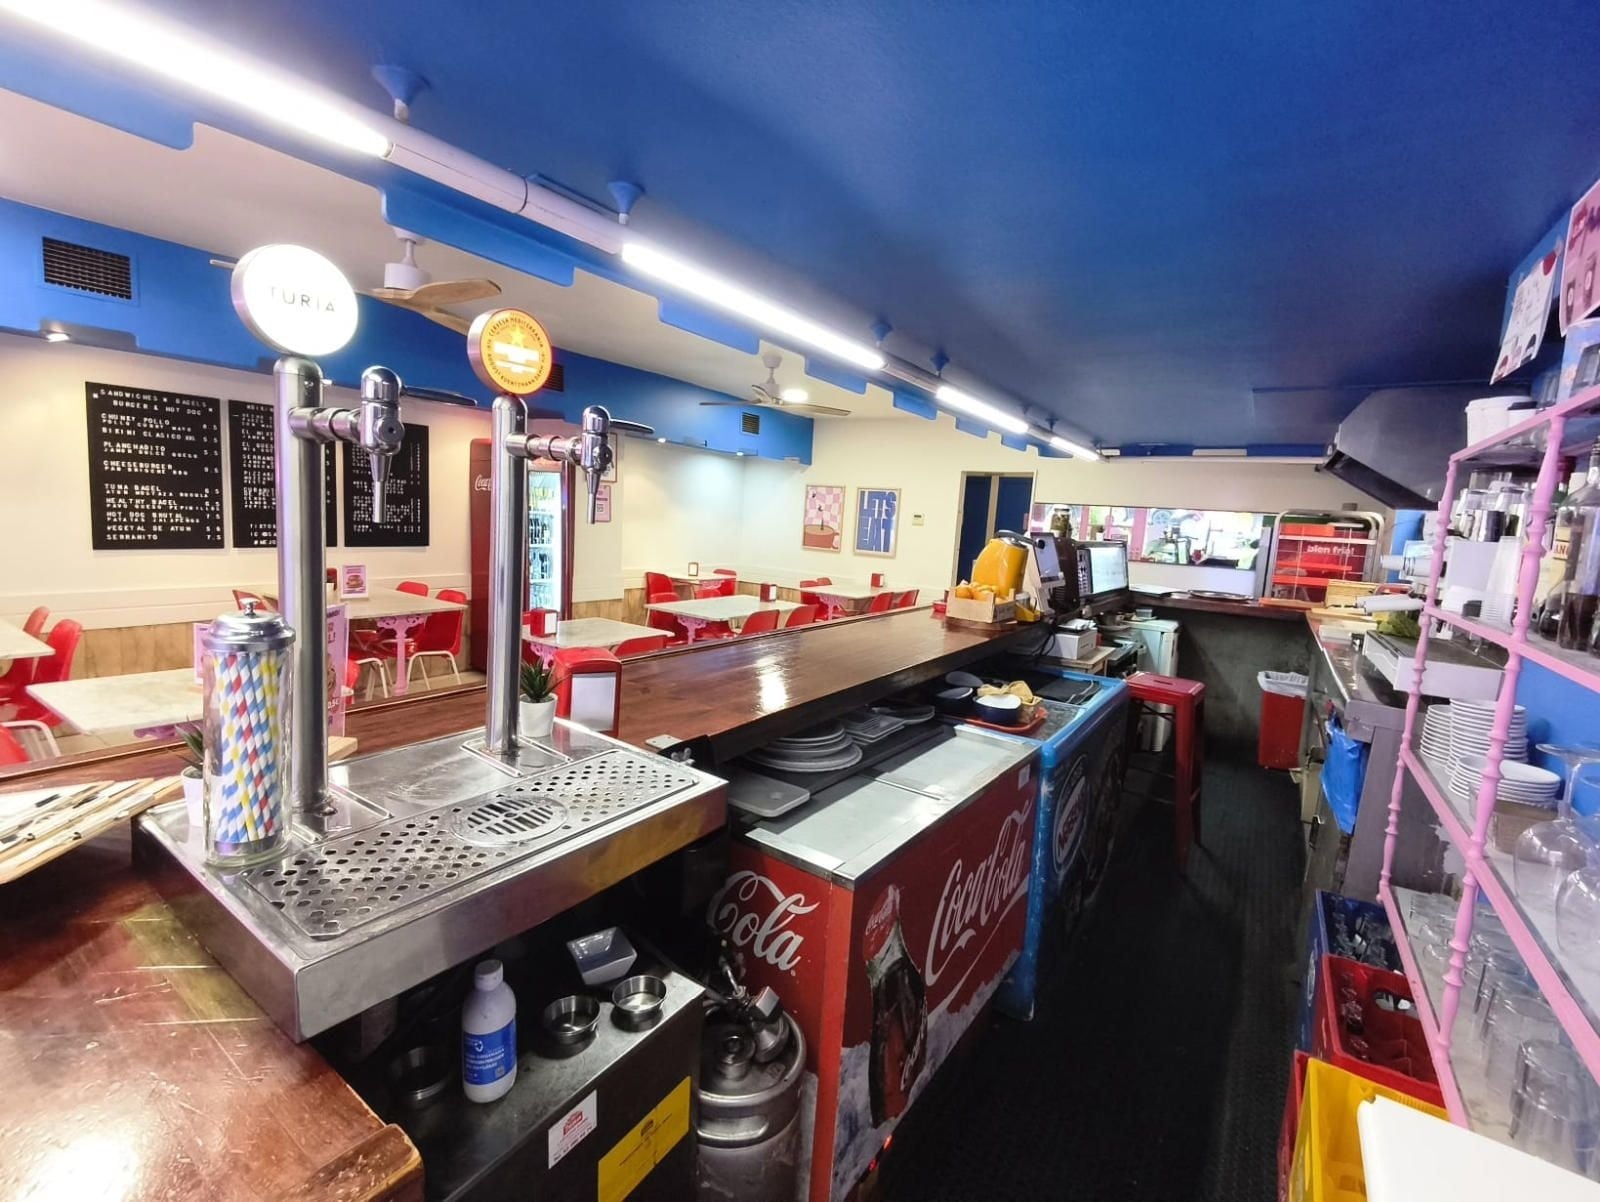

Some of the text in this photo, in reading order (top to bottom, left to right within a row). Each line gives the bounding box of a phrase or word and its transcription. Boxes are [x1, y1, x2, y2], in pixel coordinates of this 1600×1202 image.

[267, 286, 335, 312] TURIA
[100, 389, 207, 408] SANDWICHES BAGELS
[113, 399, 149, 409] BURGER
[143, 417, 170, 426] POLLO
[102, 426, 136, 436] BIKINI
[143, 431, 182, 440] CLASICO
[103, 441, 165, 452] PLANCHADITO
[103, 460, 173, 471] CHEESEBURGER
[134, 484, 161, 492] BAGEL
